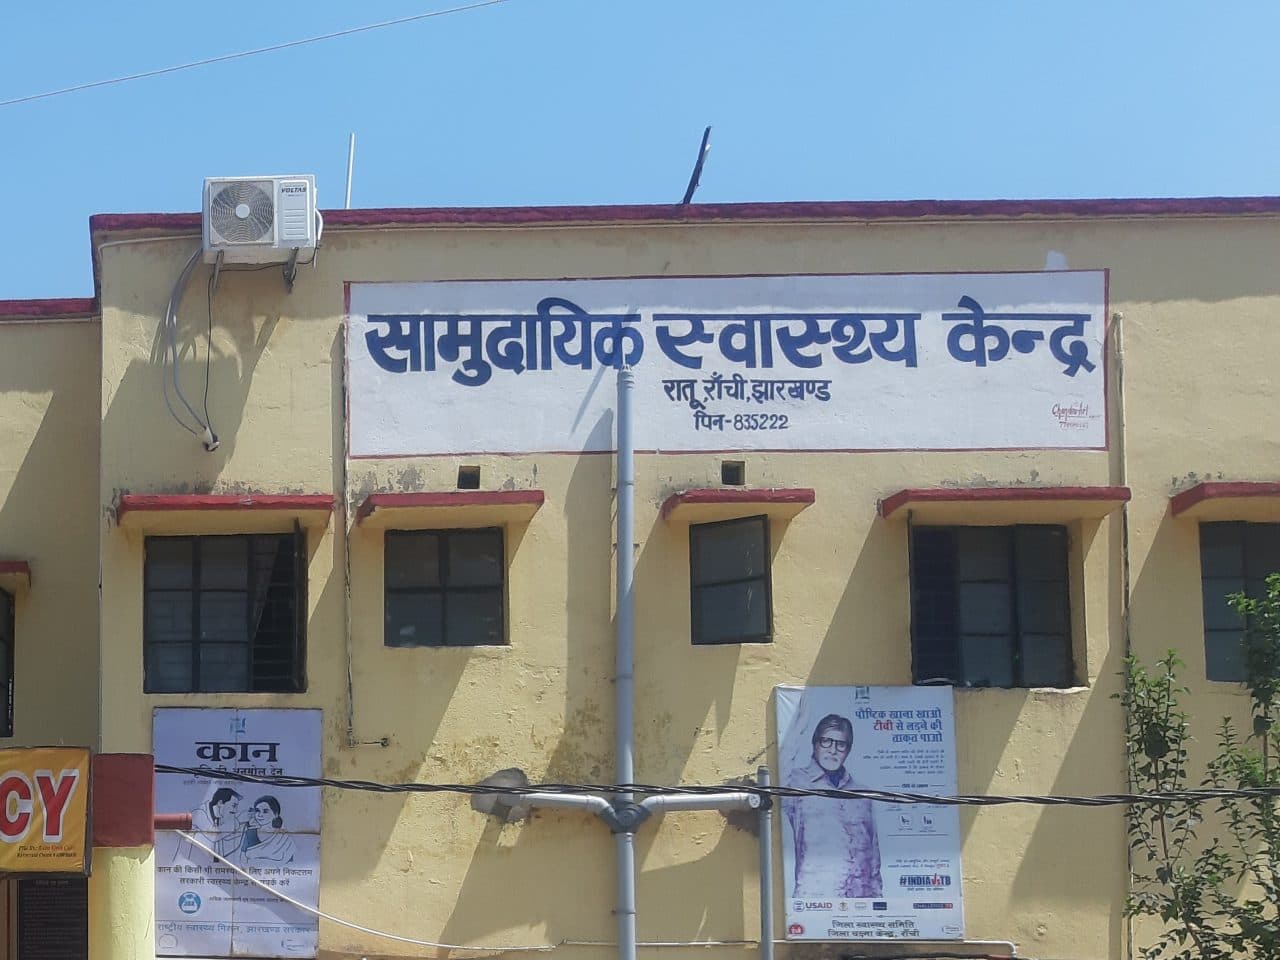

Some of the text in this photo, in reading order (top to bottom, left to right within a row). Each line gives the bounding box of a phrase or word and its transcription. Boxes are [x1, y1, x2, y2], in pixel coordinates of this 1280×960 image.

[365, 296, 1097, 386] सामुदायिक स्वास्थ्य केन्द्र
[751, 380, 832, 404] झारखण्ड
[195, 742, 280, 763] कान
